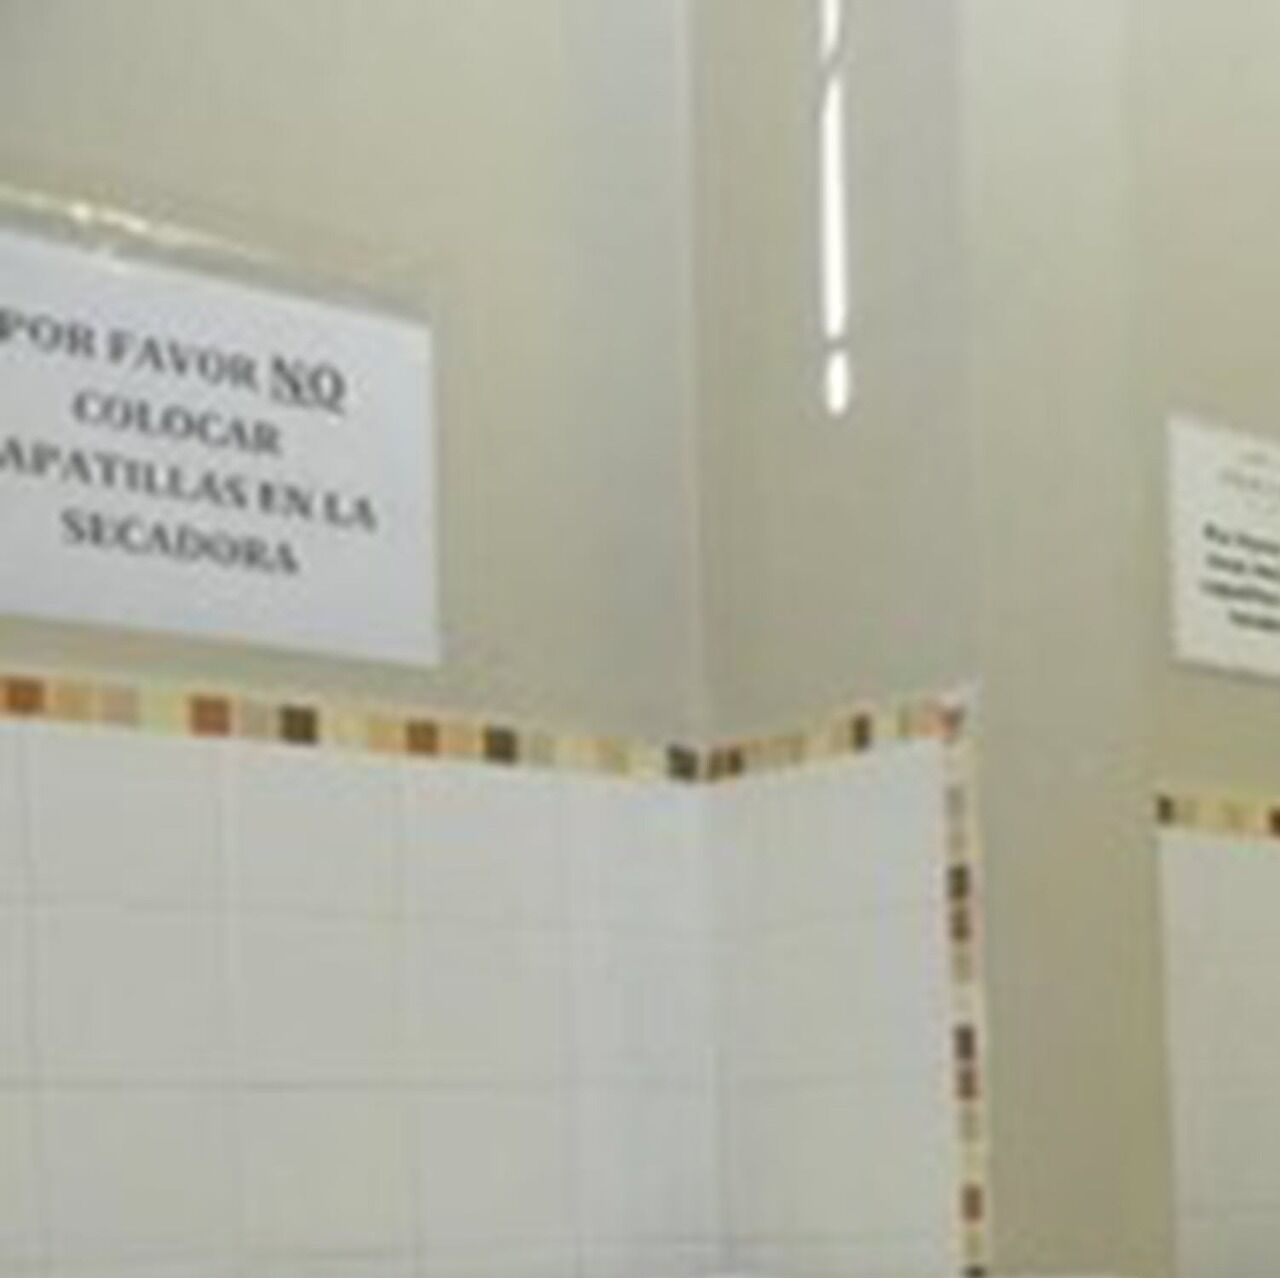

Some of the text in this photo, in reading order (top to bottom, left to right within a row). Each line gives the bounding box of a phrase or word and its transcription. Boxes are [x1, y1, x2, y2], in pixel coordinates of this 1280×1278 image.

[0, 309, 345, 412] POR FAVOR NO
[71, 390, 283, 456] COLOCAR
[260, 483, 312, 520] EN
[325, 494, 376, 531] LA
[60, 506, 301, 577] SECADORA
